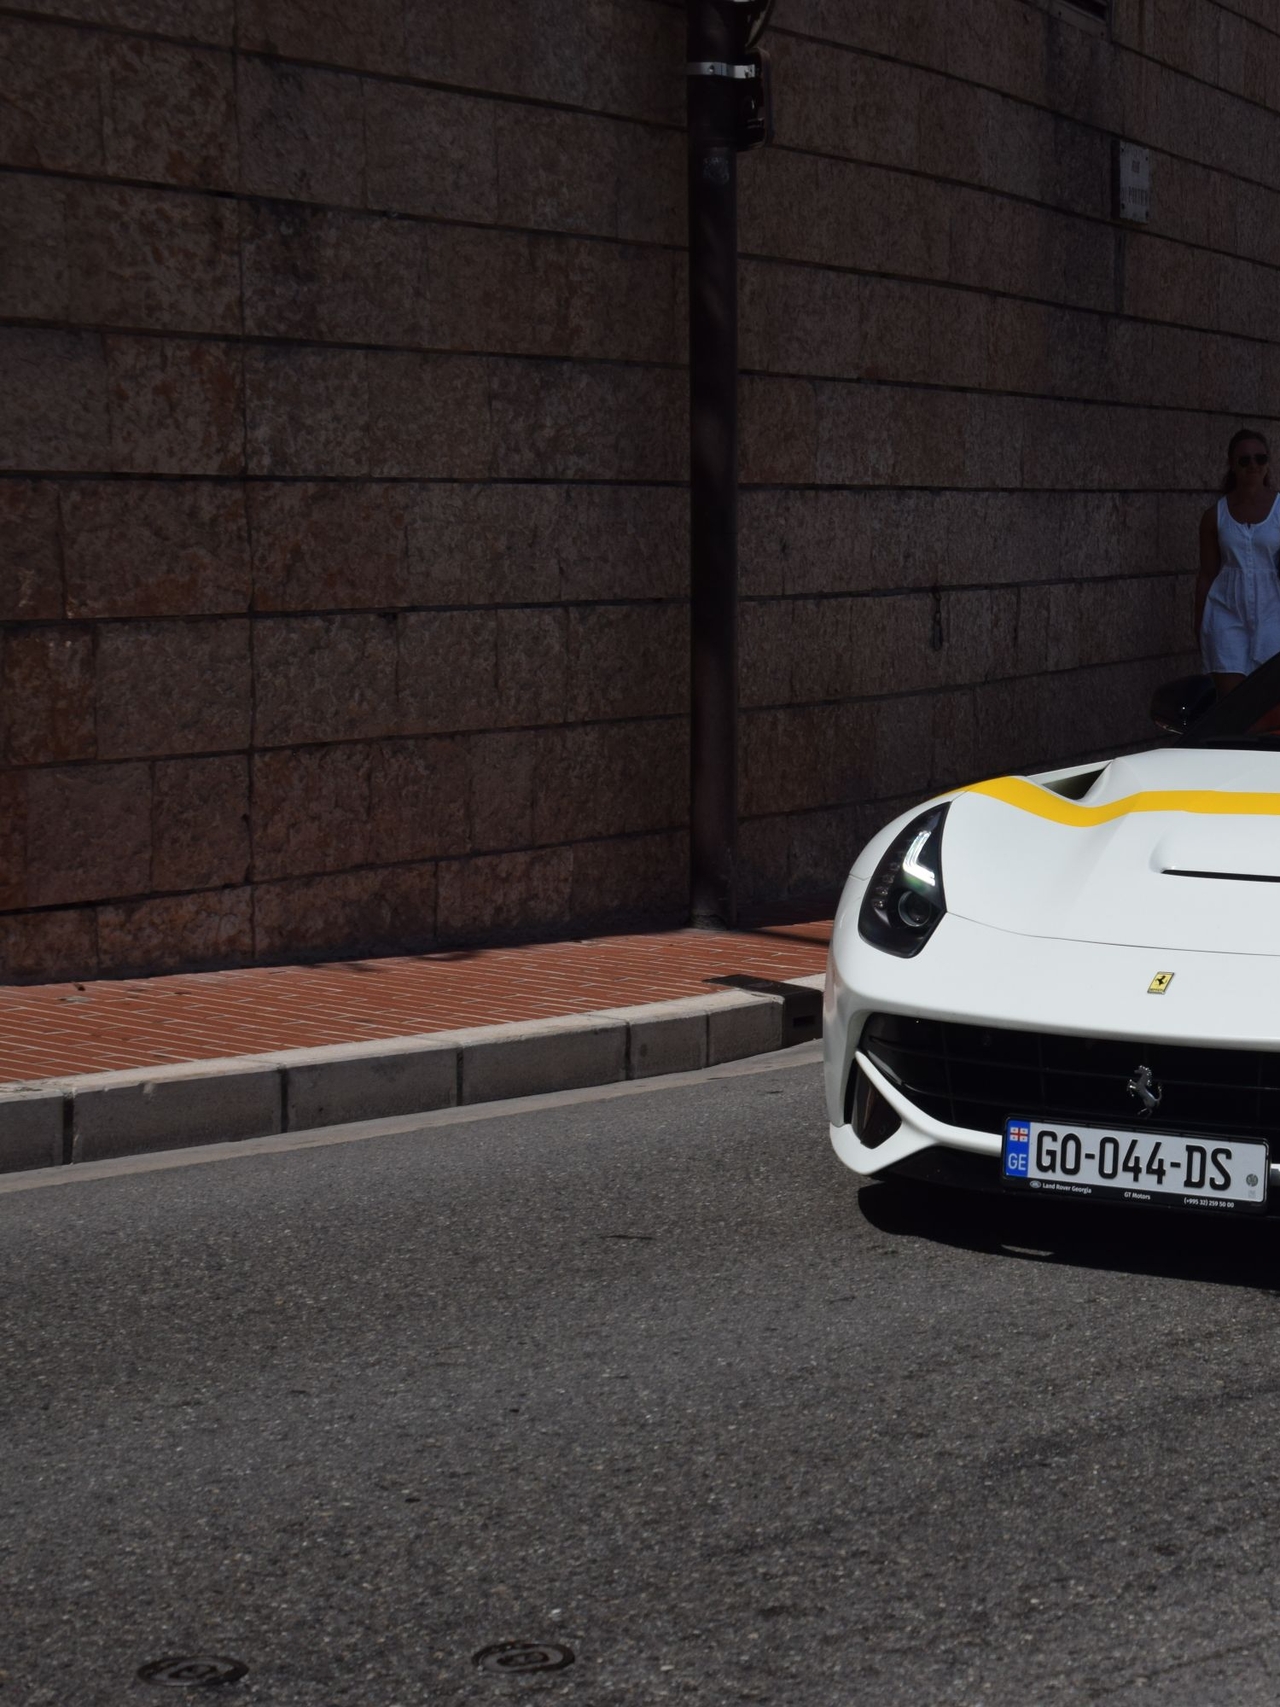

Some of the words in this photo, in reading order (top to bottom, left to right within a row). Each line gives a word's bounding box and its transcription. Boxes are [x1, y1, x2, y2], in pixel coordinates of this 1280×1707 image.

[1008, 1153, 1027, 1171] GE
[1036, 1130, 1232, 1191] GO-044-DS
[1042, 1182, 1056, 1190] Land
[1071, 1185, 1092, 1194] Georgia
[1132, 1192, 1151, 1200] Motors
[1183, 1197, 1199, 1205] (+995
